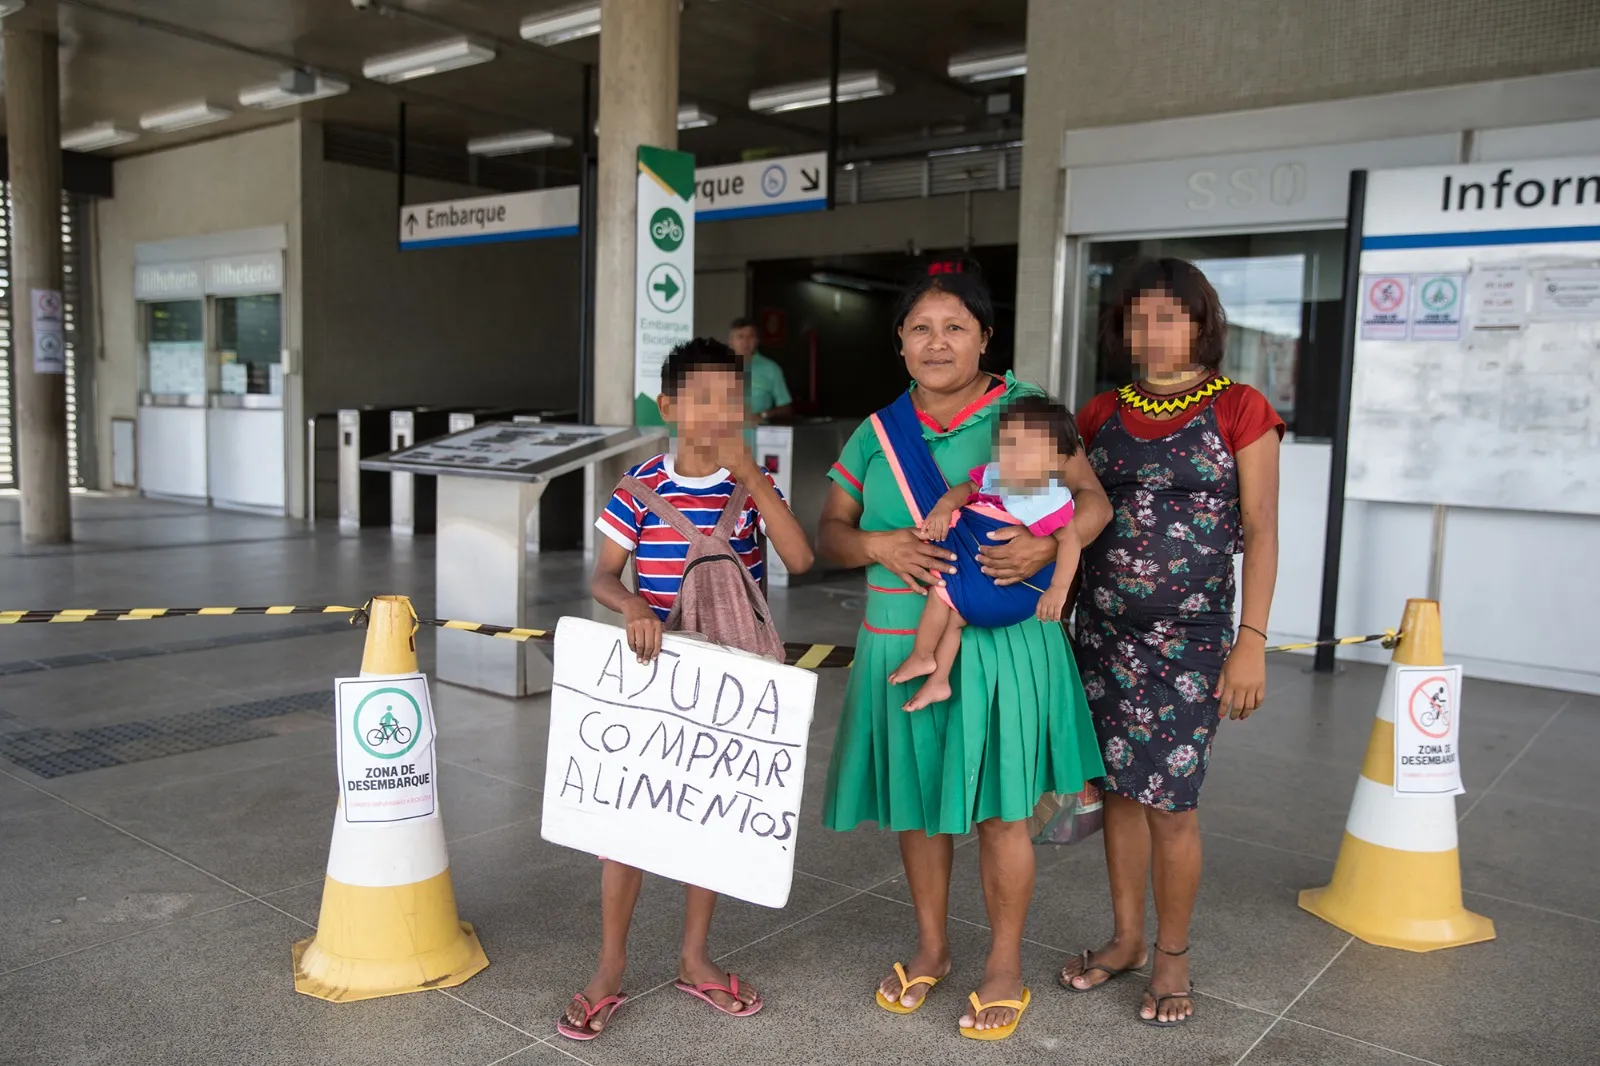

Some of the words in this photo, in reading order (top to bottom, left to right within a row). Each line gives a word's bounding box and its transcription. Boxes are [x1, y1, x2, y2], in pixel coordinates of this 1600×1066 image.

[1185, 161, 1308, 211] SSO
[426, 205, 506, 229] Embarque
[597, 639, 779, 734] AJUDA
[579, 711, 792, 787] COMPRAR
[1418, 745, 1443, 755] ZONA
[347, 773, 430, 791] DESEMBARQUE
[365, 766, 398, 778] ZONA
[401, 764, 416, 775] DE
